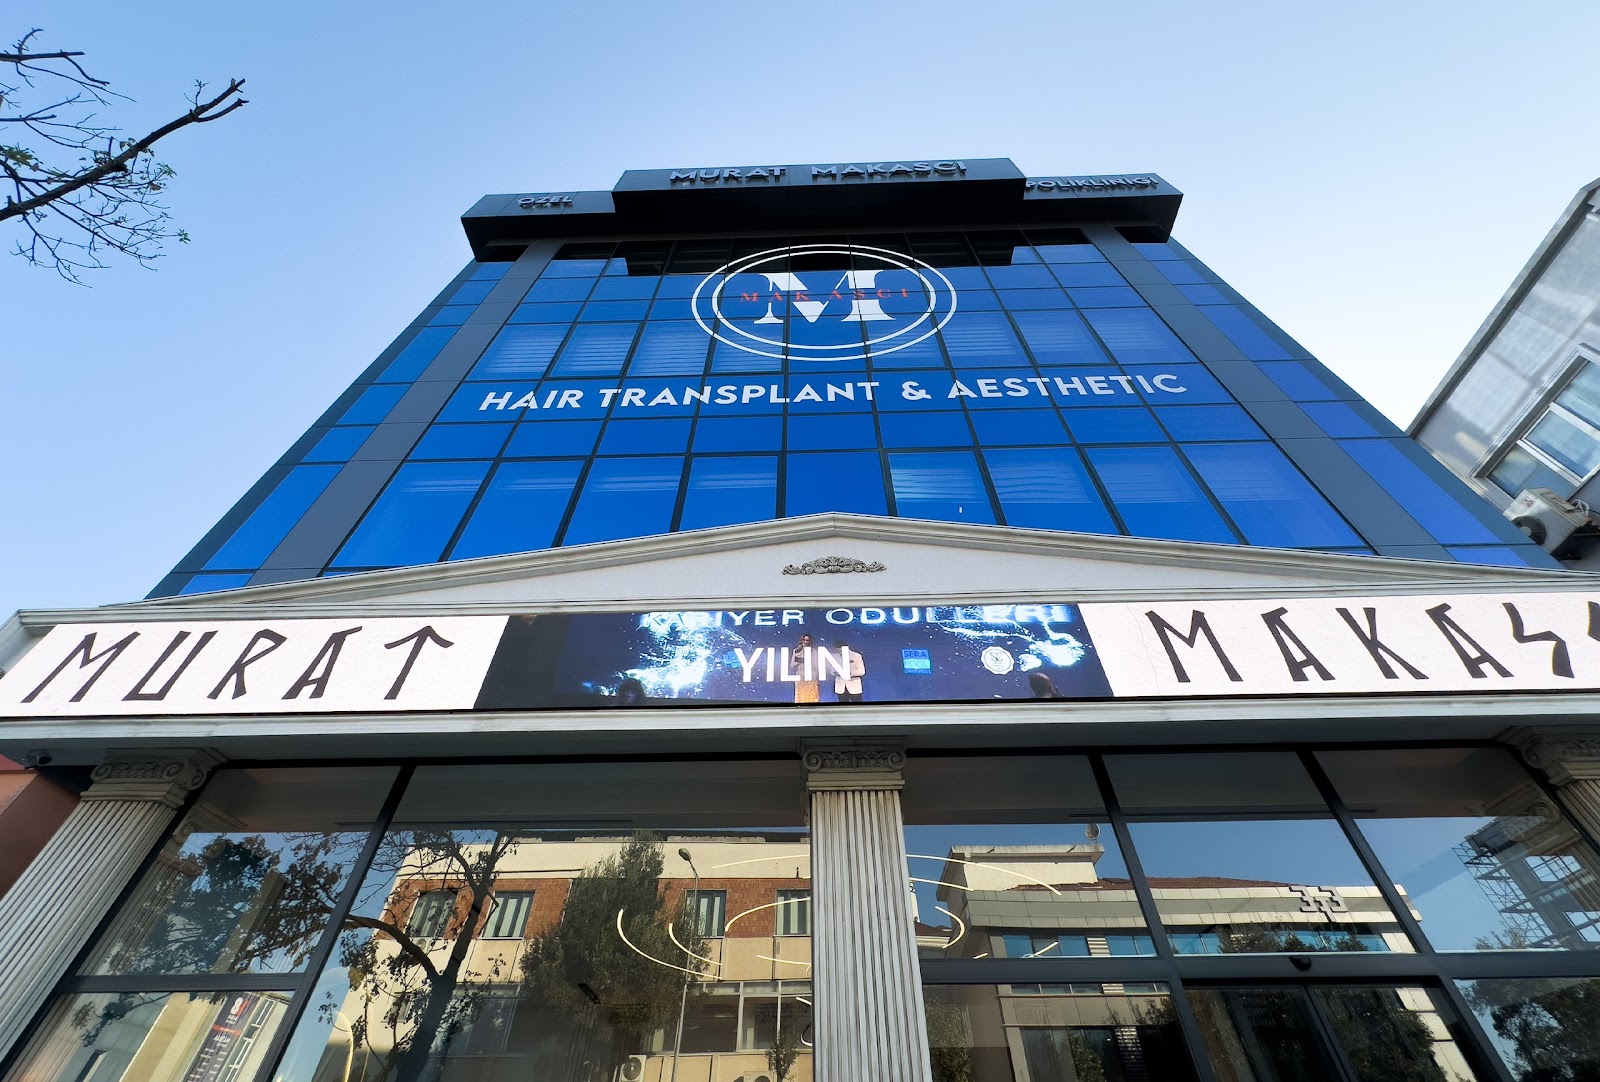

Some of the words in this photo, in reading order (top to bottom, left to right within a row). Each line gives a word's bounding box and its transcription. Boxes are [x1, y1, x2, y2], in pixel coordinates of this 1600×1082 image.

[669, 166, 786, 182] MURAT
[811, 160, 967, 177] MAKASCI
[740, 288, 908, 302] MAKASCI
[479, 389, 584, 410] HAIR
[599, 381, 880, 408] TRANSPLANT
[901, 381, 932, 400] &
[947, 374, 1188, 399] AESTHETIC
[1145, 600, 1600, 683] MAKAS
[20, 625, 454, 704] MURAT
[734, 646, 852, 681] YILIN
